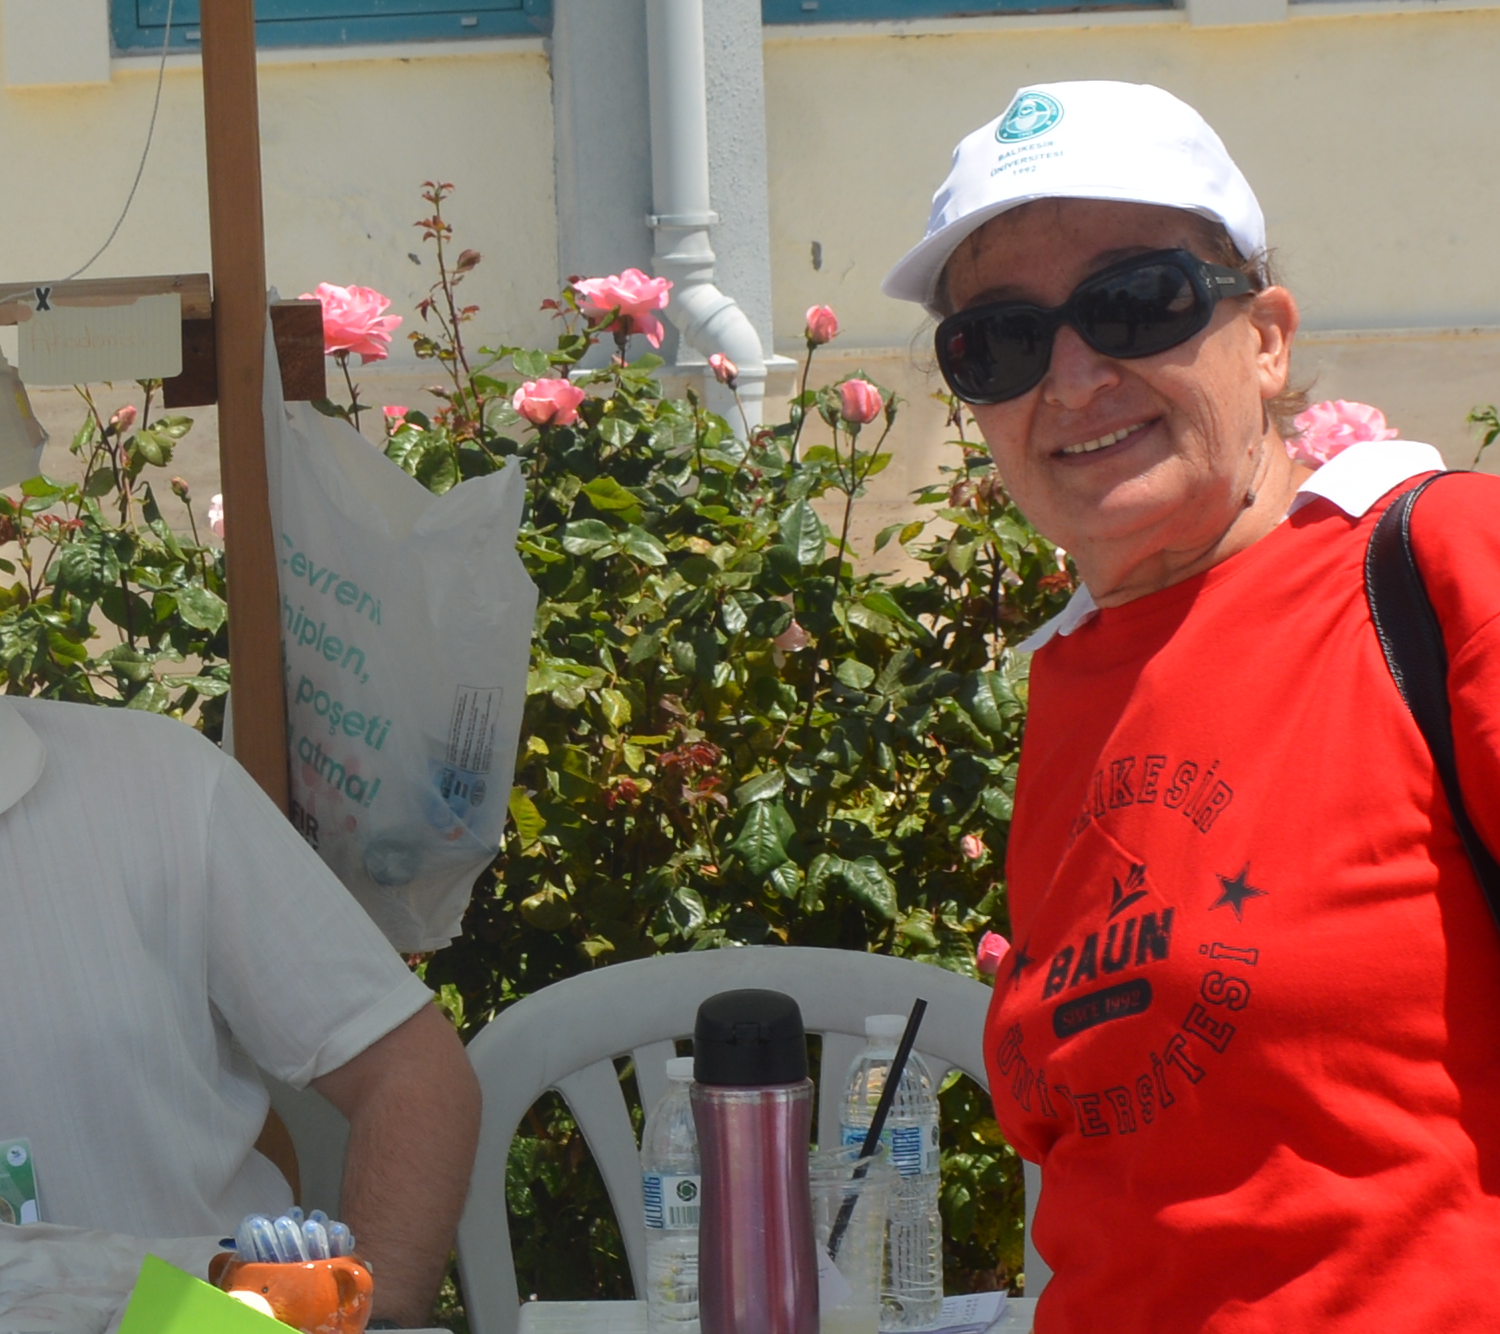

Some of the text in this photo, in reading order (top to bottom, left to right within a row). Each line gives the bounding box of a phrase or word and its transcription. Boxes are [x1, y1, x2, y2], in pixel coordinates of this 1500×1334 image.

[294, 673, 393, 751] poşeti
[297, 732, 383, 808] atma!
[1041, 907, 1176, 1002] BAUN
[1060, 991, 1142, 1028] SINCE 1992
